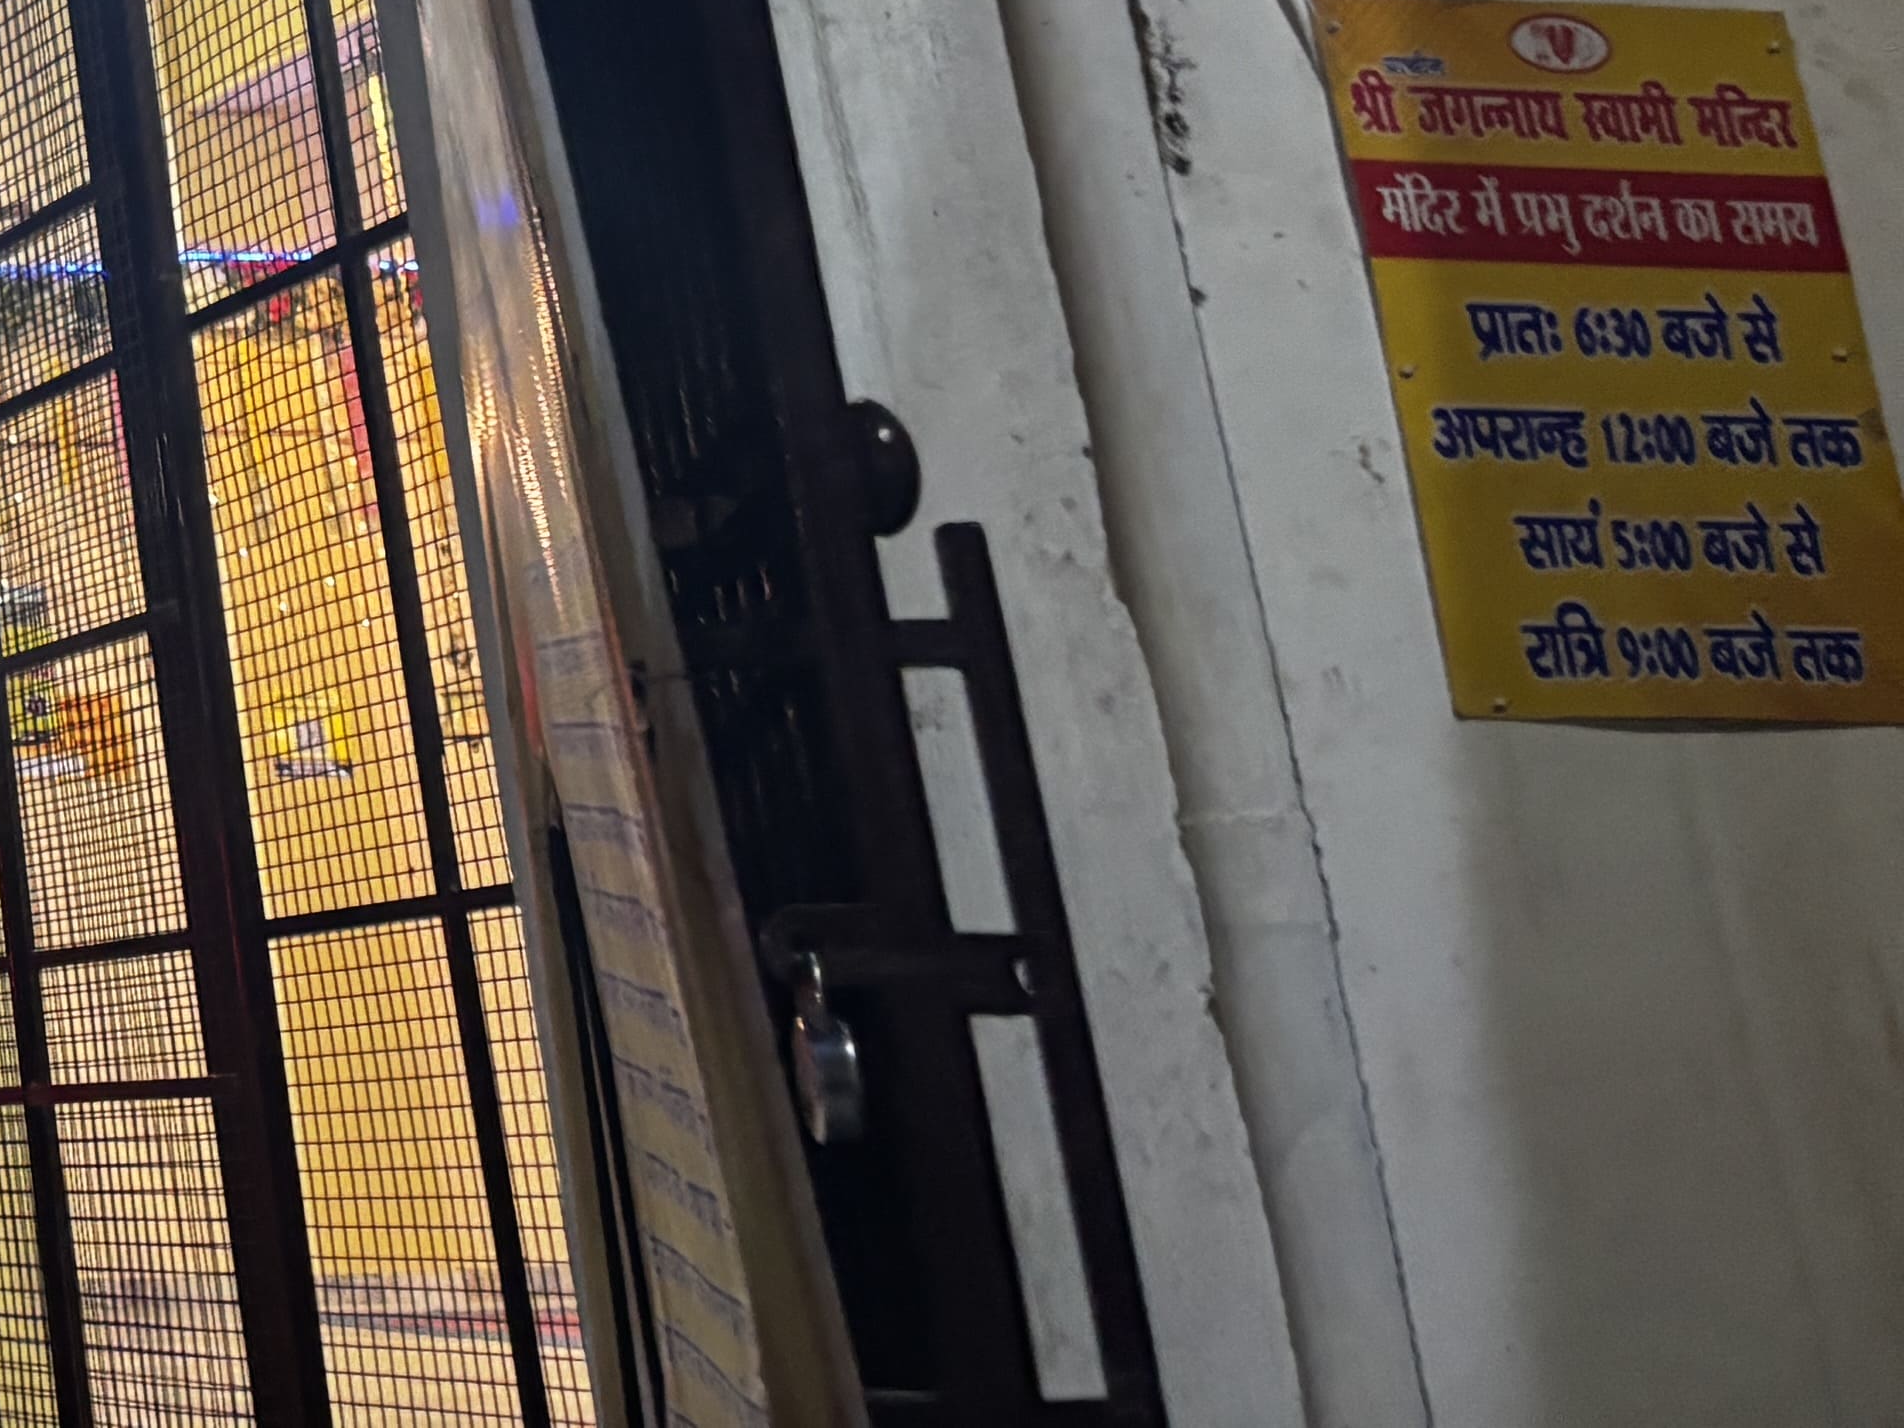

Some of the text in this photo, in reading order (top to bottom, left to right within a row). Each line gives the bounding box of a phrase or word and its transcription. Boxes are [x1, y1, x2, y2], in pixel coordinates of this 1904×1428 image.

[1350, 69, 1402, 134] श्री
[1573, 80, 1683, 145] स्वामी
[1472, 174, 1507, 236] में
[1512, 193, 1582, 255] प्रभु
[1579, 179, 1669, 242] दर्शन
[1670, 199, 1722, 243] का
[1725, 201, 1819, 248] समय
[1575, 307, 1652, 358] 6:30
[1656, 292, 1733, 361] बजे
[1737, 294, 1782, 364] से
[1601, 413, 1696, 466] 12:00
[1701, 396, 1778, 466] बजे
[1782, 415, 1861, 467] तक
[1514, 498, 1825, 575] सायं 5:00 बजे से
[1521, 602, 1863, 681] रात्रि 9:00 बजे तक
